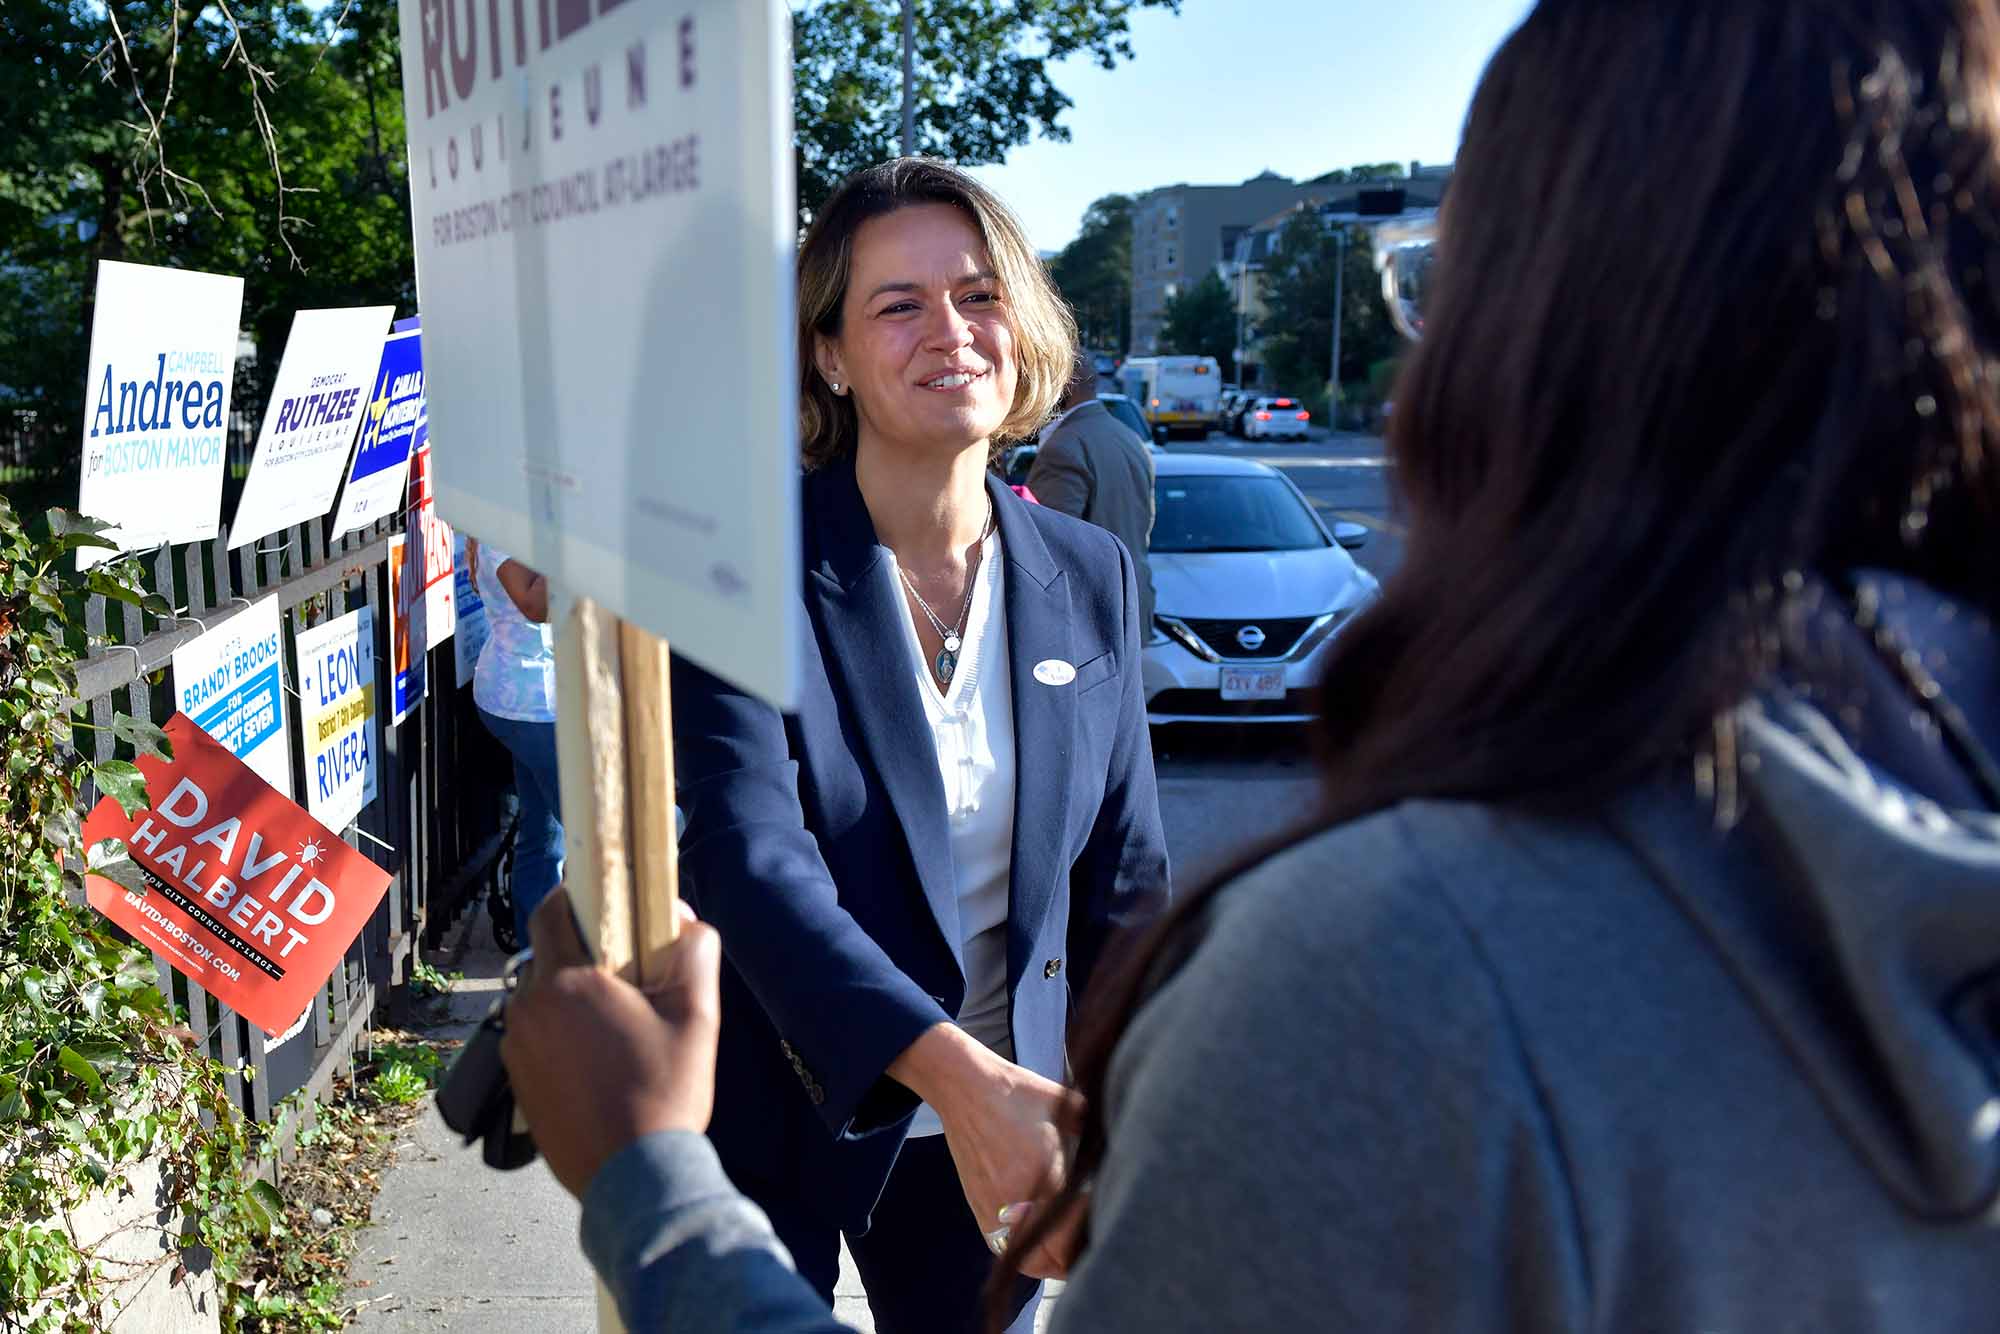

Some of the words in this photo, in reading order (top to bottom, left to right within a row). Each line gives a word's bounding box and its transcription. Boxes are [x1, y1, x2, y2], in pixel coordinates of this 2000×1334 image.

[91, 353, 223, 437] Andrea
[168, 351, 224, 374] CAMPBELL
[275, 387, 360, 435] RUTHZEE
[88, 450, 103, 478] for
[104, 438, 162, 476] BOSTON
[166, 435, 220, 470] MAYOR
[184, 661, 231, 713] BRANDY
[234, 633, 278, 679] BROOKS
[227, 692, 243, 713] FOR
[318, 640, 360, 706] LEON
[244, 704, 274, 744] SEVEN
[317, 724, 370, 803] RIVERA
[156, 777, 336, 926] DAVID
[130, 818, 309, 959] HALBERT
[164, 887, 187, 906] CITY
[188, 905, 228, 939] COUNCIL
[123, 891, 240, 983] DAVID4BOSTON.COM
